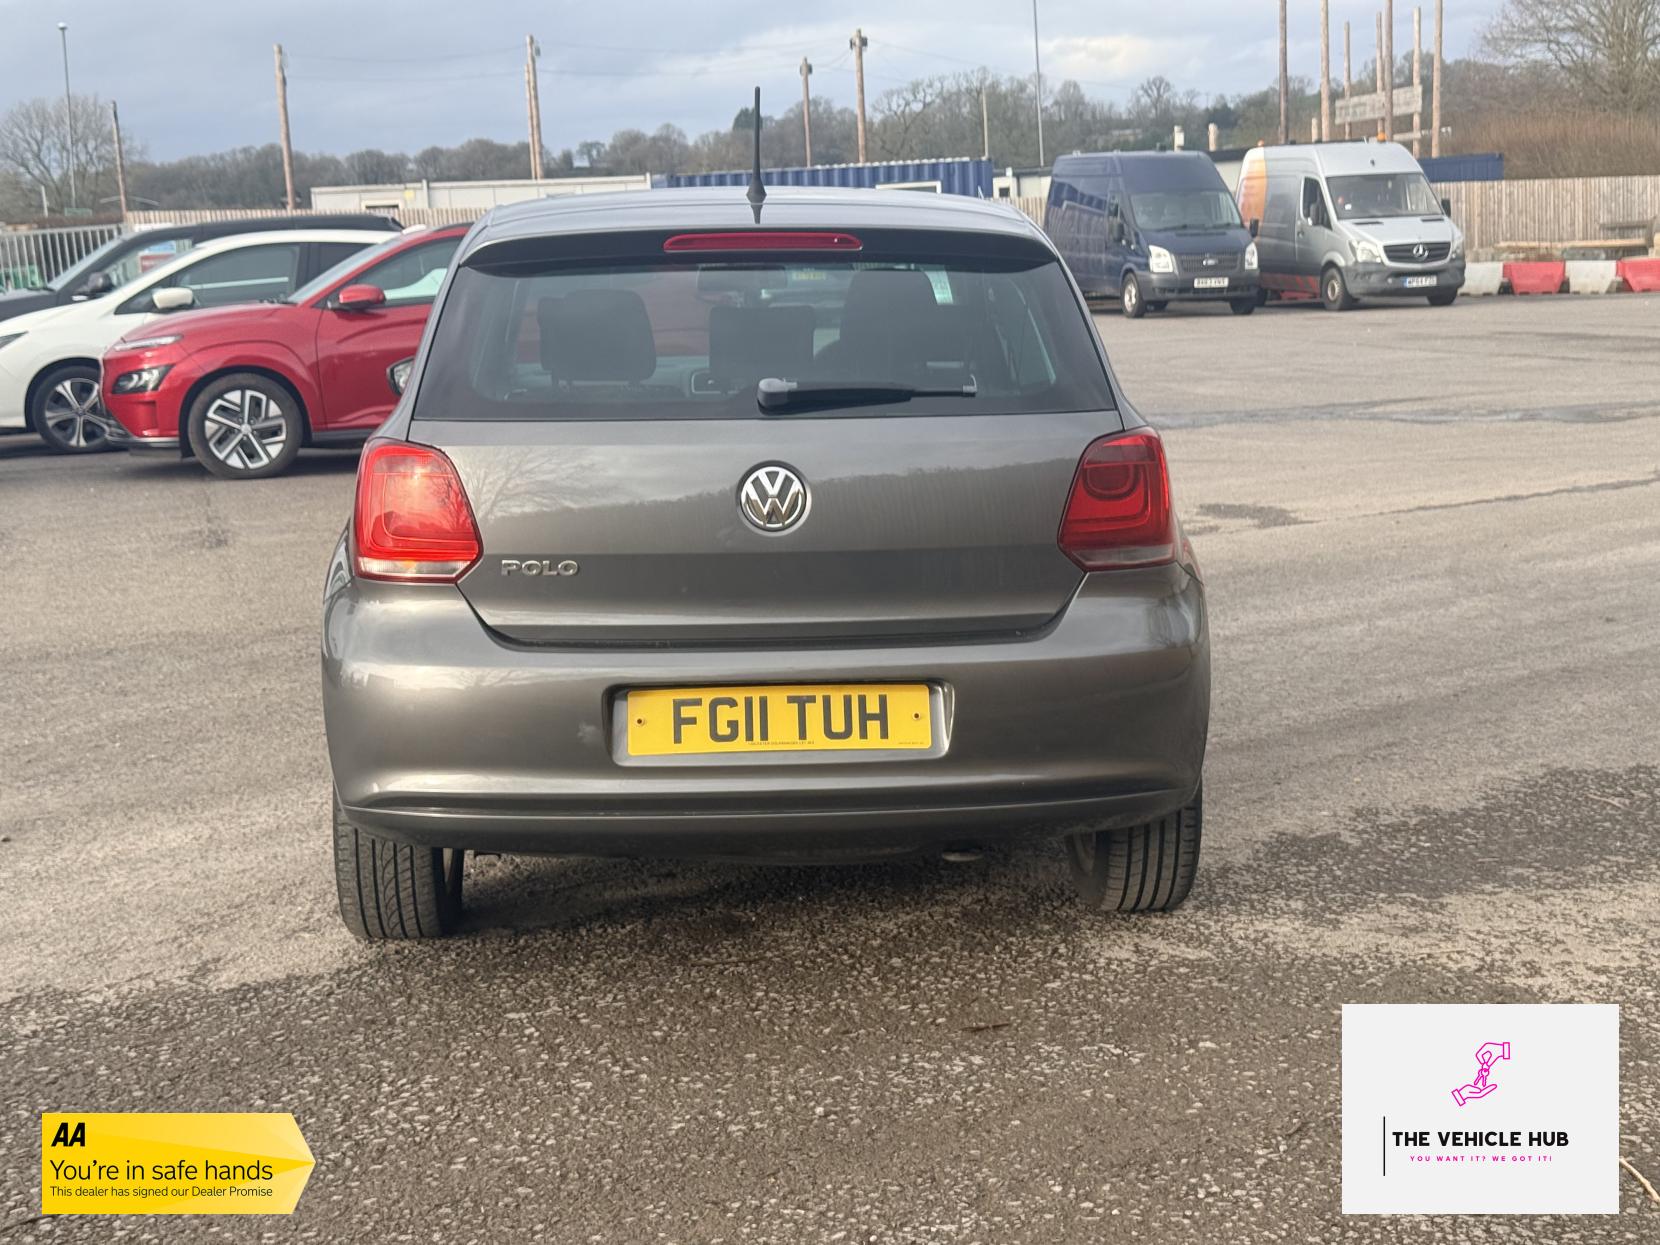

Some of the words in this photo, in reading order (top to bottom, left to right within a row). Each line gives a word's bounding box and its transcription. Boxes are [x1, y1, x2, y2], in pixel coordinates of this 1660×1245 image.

[501, 559, 580, 577] POLO
[672, 696, 768, 744] FG11
[786, 694, 889, 741] TUH
